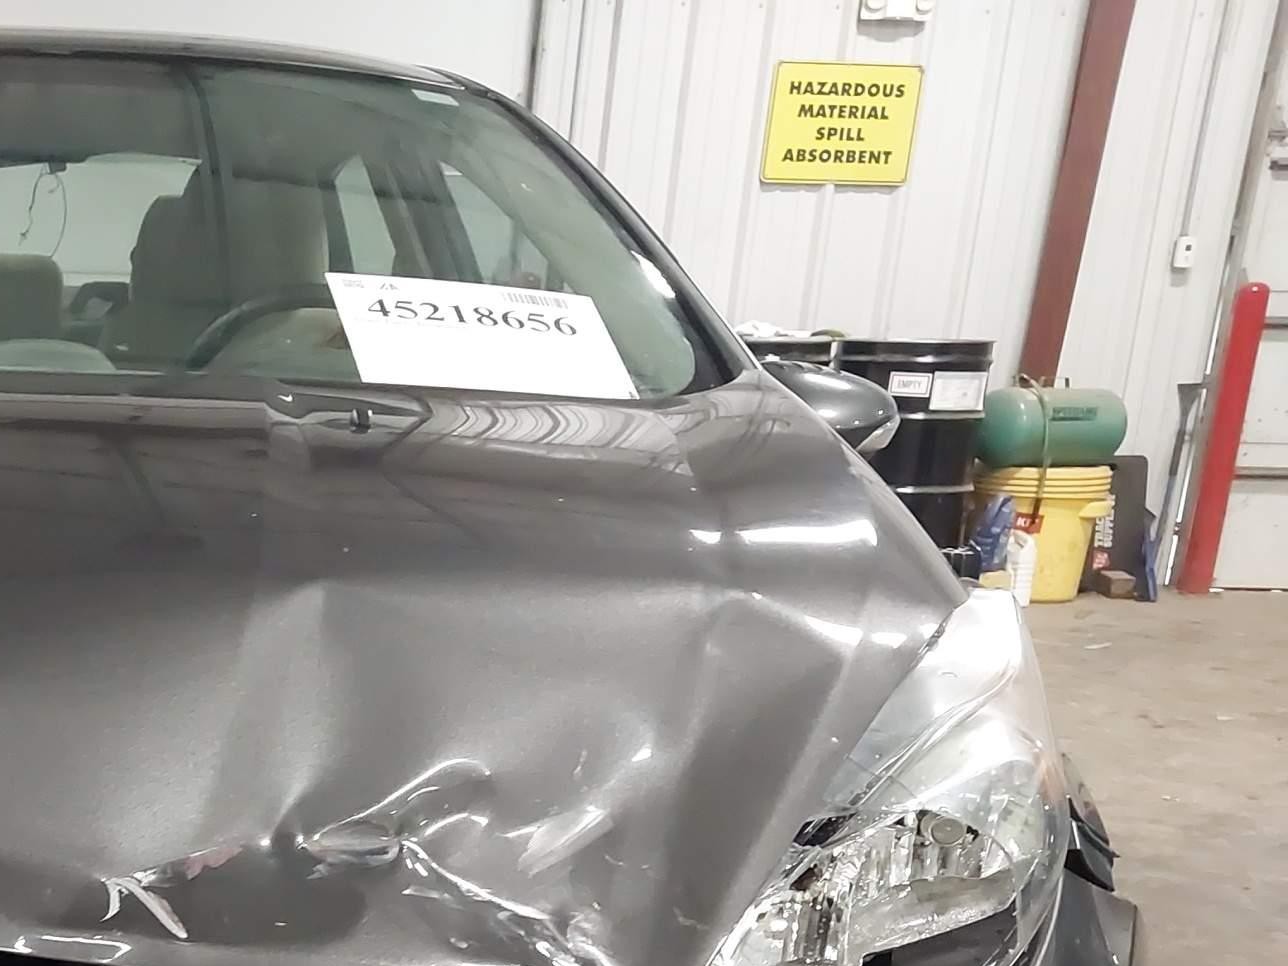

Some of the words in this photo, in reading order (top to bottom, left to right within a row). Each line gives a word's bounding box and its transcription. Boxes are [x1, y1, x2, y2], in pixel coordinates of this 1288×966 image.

[789, 81, 905, 98] HAZARDOUS
[797, 104, 889, 120] MATERIAL
[815, 127, 865, 141] SPILL
[782, 148, 892, 164] ABSORBENT
[368, 298, 577, 336] 45218656
